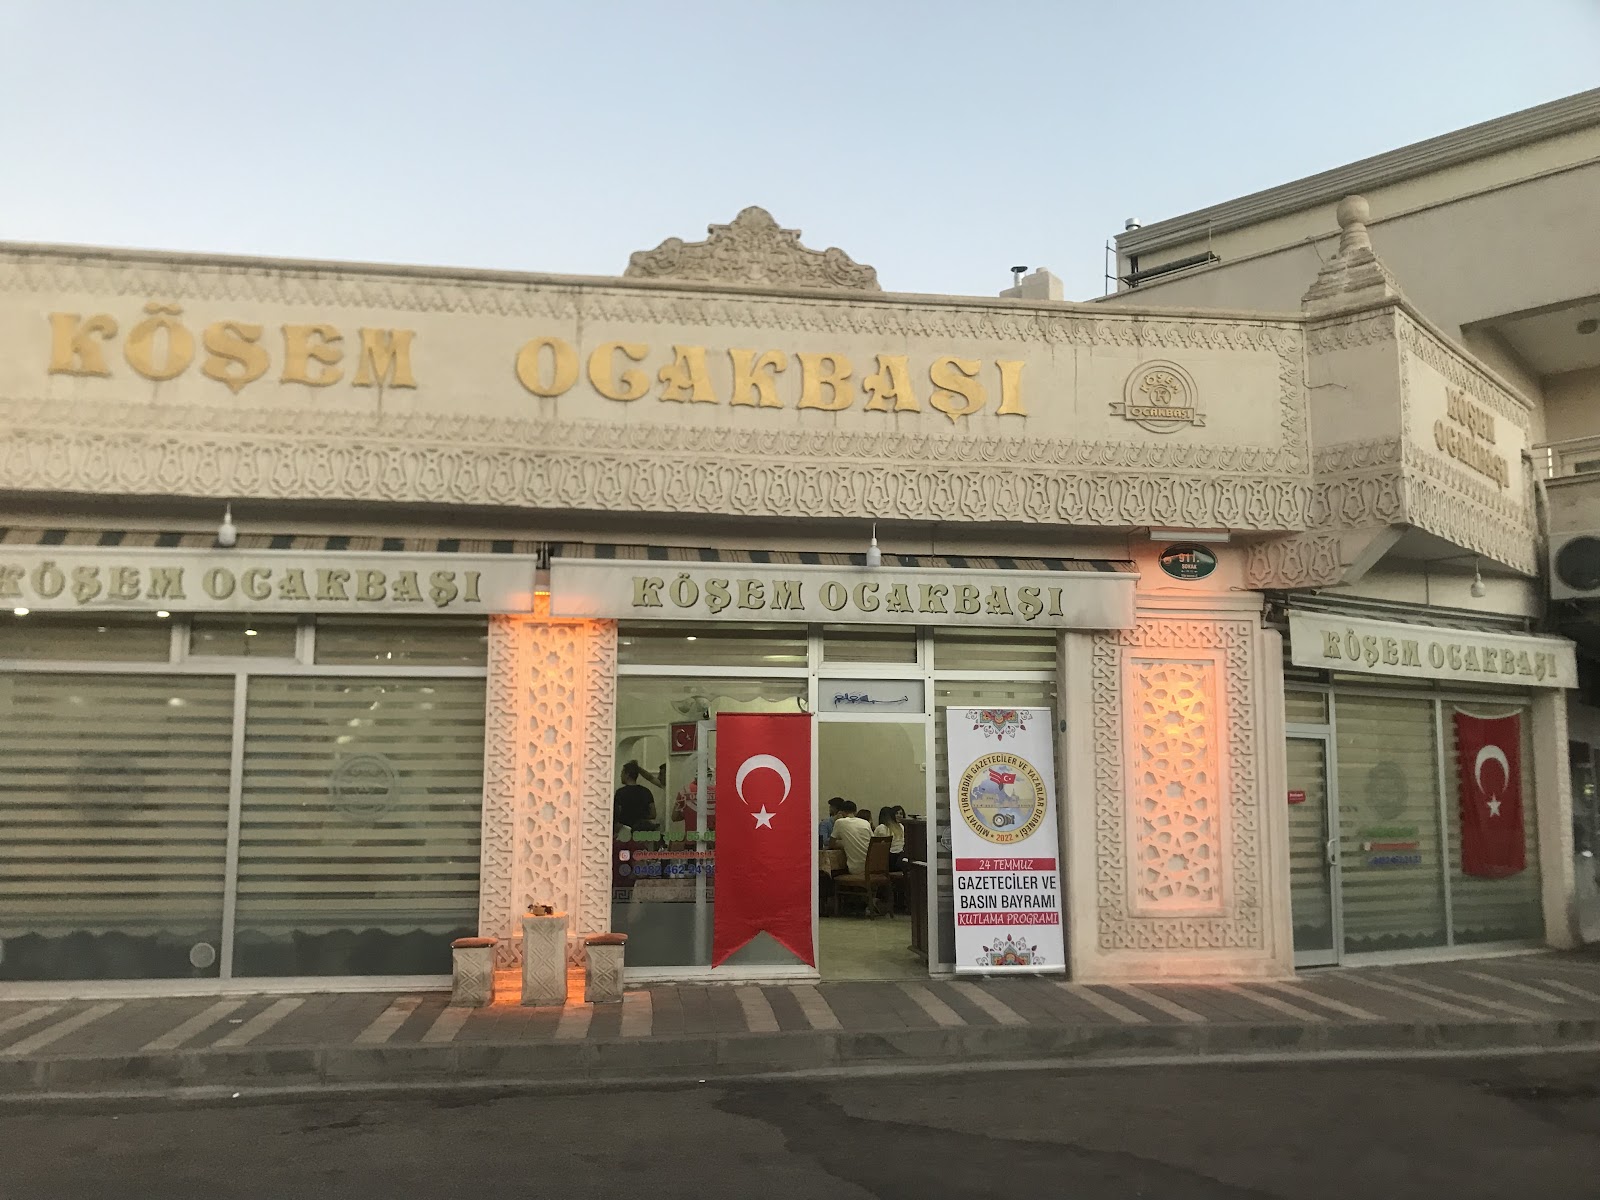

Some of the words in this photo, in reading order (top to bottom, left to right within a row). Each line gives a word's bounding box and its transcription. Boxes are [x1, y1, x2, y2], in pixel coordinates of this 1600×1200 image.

[48, 301, 417, 395] KÖŞEM
[515, 336, 1028, 425] OCAKBAŞI
[201, 565, 483, 608] OCAKBAŞI
[631, 571, 807, 615] KÖŞEM
[818, 579, 1064, 622] OCAKBAŞI
[1320, 627, 1422, 668] KÖŞEM
[1428, 640, 1558, 681] OCAKBAŞI
[970, 753, 1017, 774] GAZETECİLER
[1018, 761, 1028, 771] VE
[1027, 769, 1045, 807] YAZARLAR
[966, 815, 991, 838] MİDYAT
[1019, 808, 1043, 838] DERNEĞİ
[996, 834, 1013, 842] 2022
[979, 860, 991, 870] 24
[993, 859, 1034, 870] TEMMUZ
[958, 873, 1038, 890] GAZETECİLER
[1041, 876, 1057, 890] VE
[960, 895, 997, 909] BASIN
[1001, 895, 1056, 909] BAYRAMI
[958, 913, 1005, 925] KUTLAMA
[1006, 912, 1058, 925] PROGRAMI
